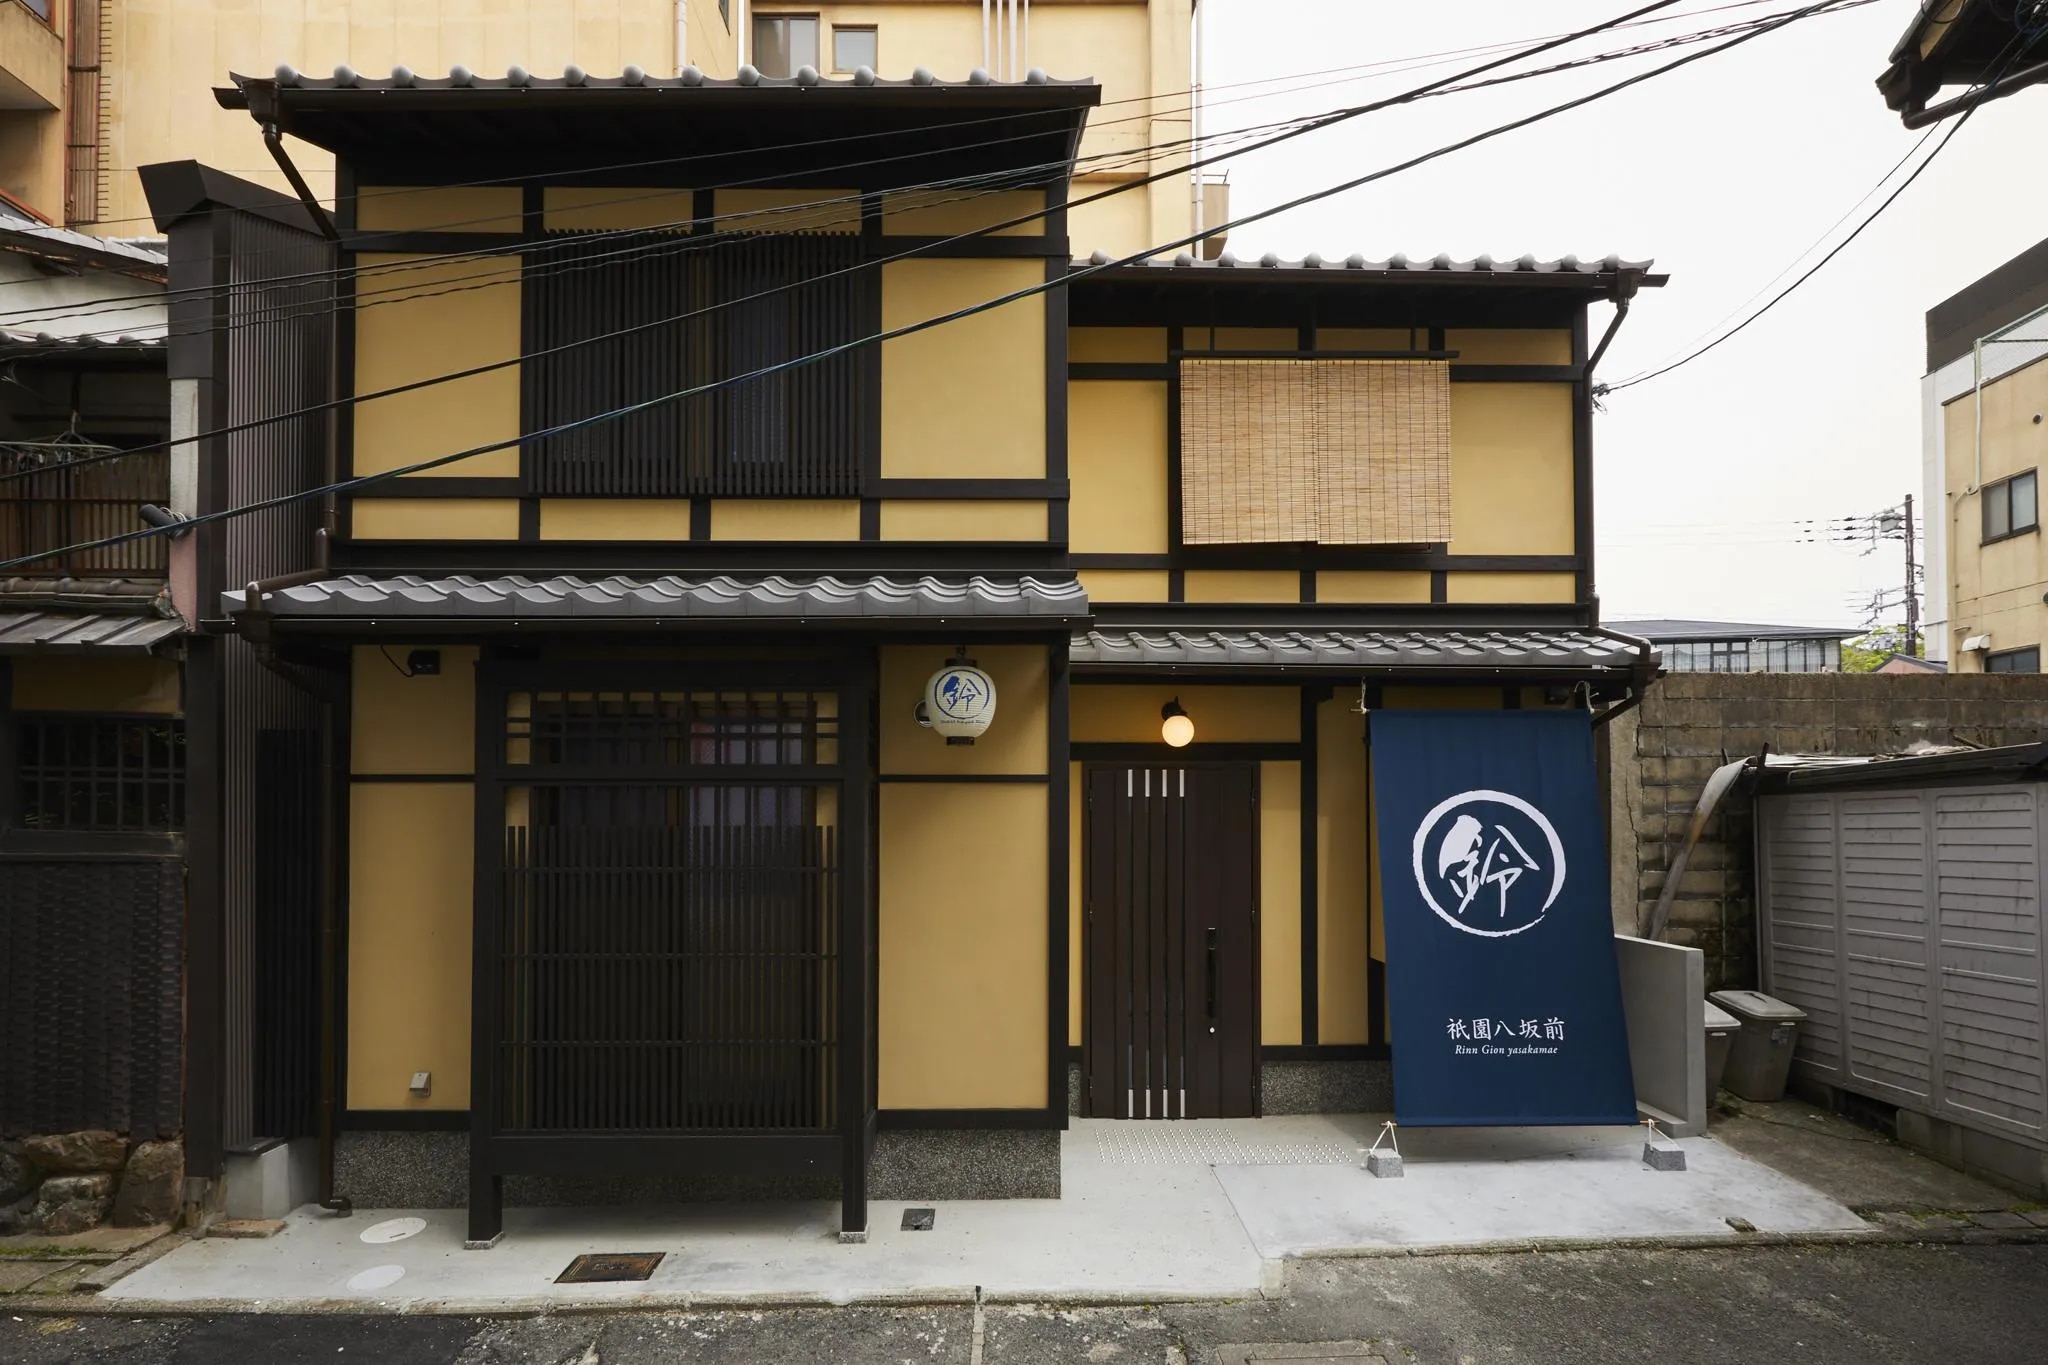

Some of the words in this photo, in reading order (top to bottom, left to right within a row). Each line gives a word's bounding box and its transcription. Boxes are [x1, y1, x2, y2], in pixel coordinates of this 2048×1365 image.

[1446, 1016, 1565, 1041] 祇園八坂前
[1455, 1044, 1478, 1055] Rinn
[1481, 1044, 1505, 1055] Gion
[1506, 1044, 1558, 1057] yasakamae
